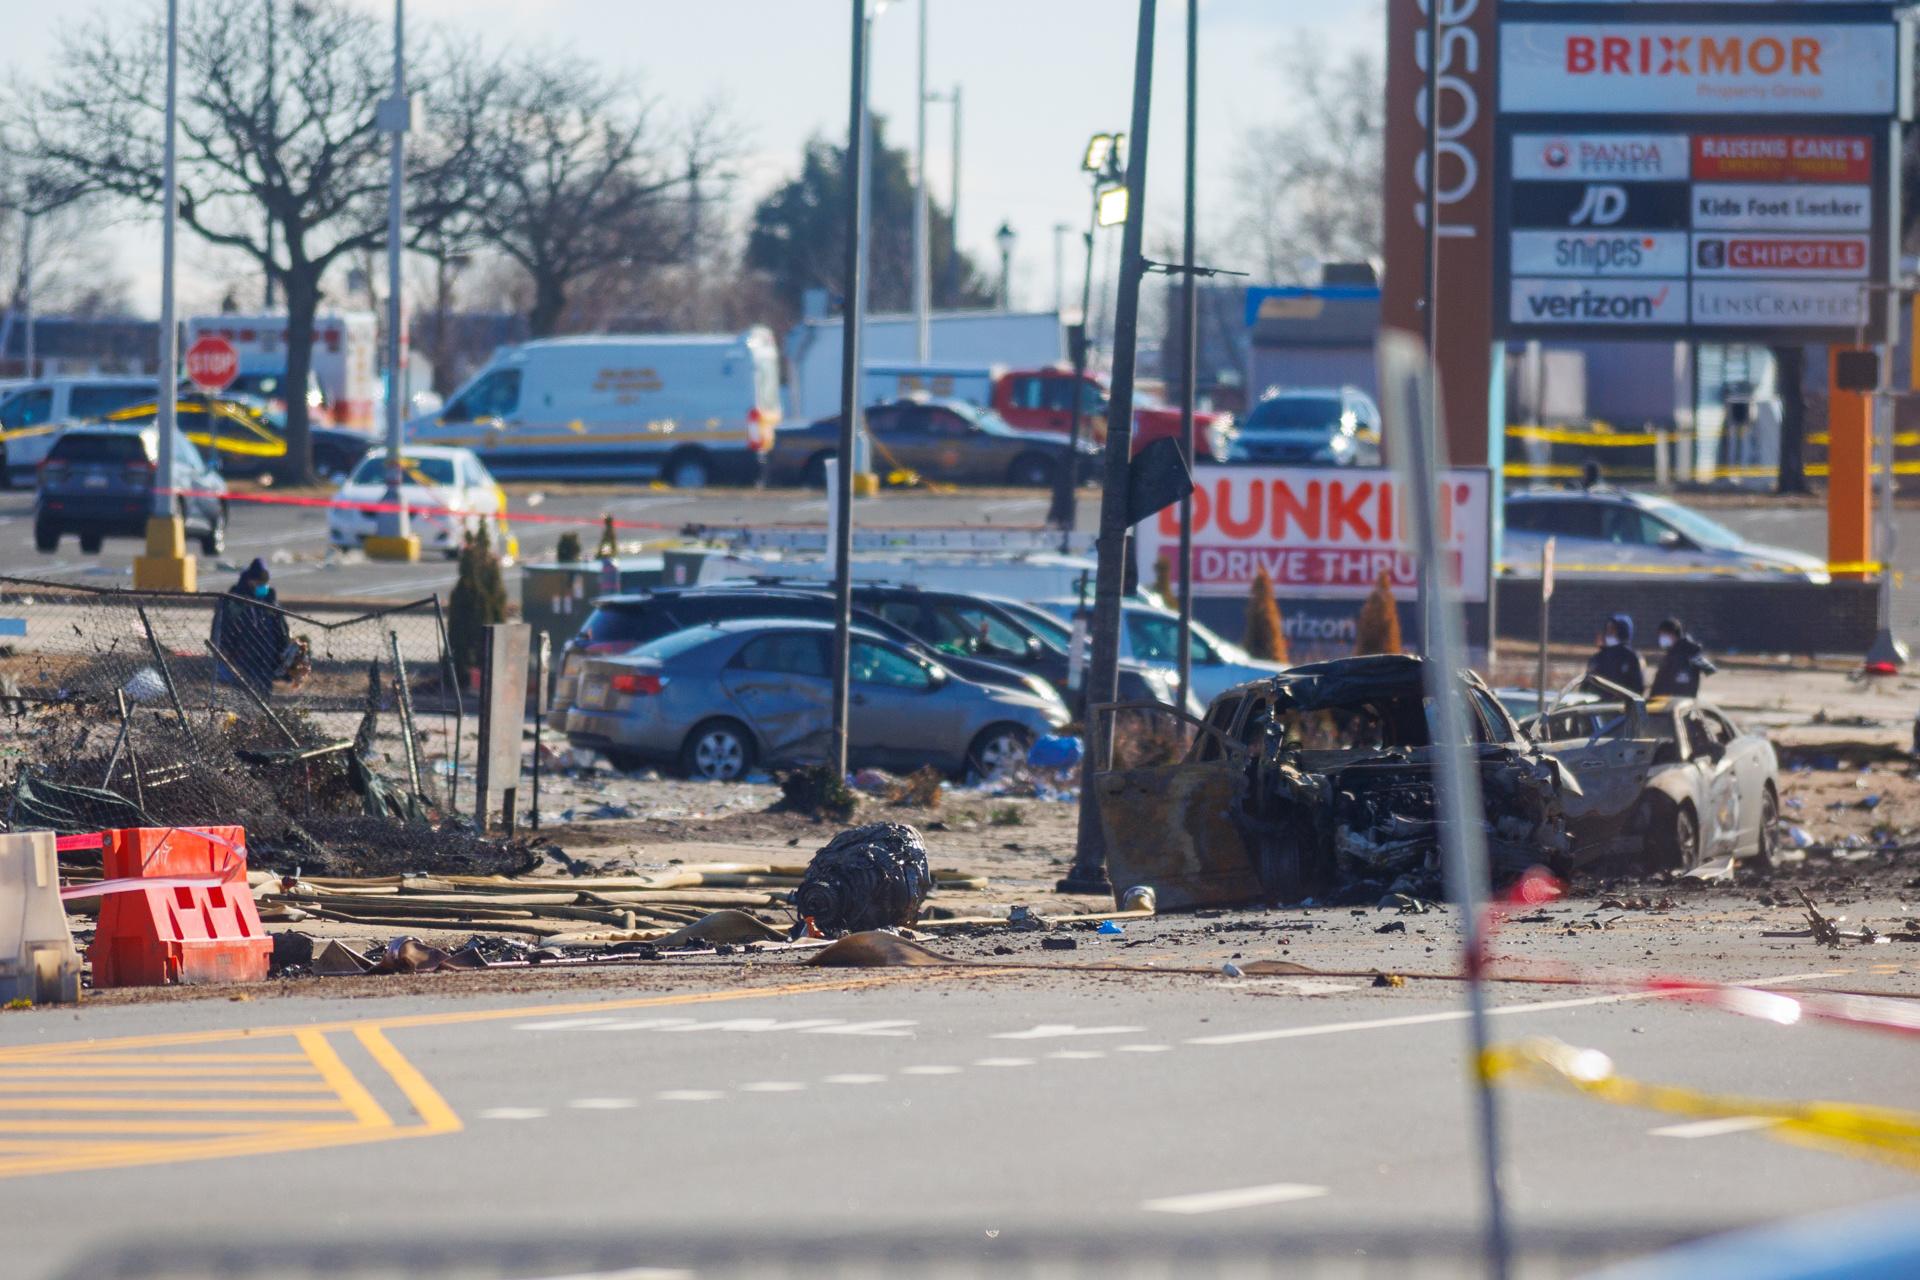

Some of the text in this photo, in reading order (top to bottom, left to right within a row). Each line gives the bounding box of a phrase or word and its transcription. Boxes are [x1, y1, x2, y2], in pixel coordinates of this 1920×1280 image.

[1566, 36, 1822, 75] BRIXMOR
[1579, 142, 1662, 162] PANDA
[1701, 139, 1866, 161] RAISING CANE'S
[1569, 184, 1629, 226] JD
[1700, 199, 1863, 216] Kids Foot Locker
[1556, 236, 1642, 275] snipes
[1732, 244, 1860, 266] CHIPOTLE
[1528, 289, 1653, 317] verizon
[190, 351, 237, 374] STOP
[1202, 551, 1306, 580] DRIVE
[1284, 612, 1356, 638] rizon
